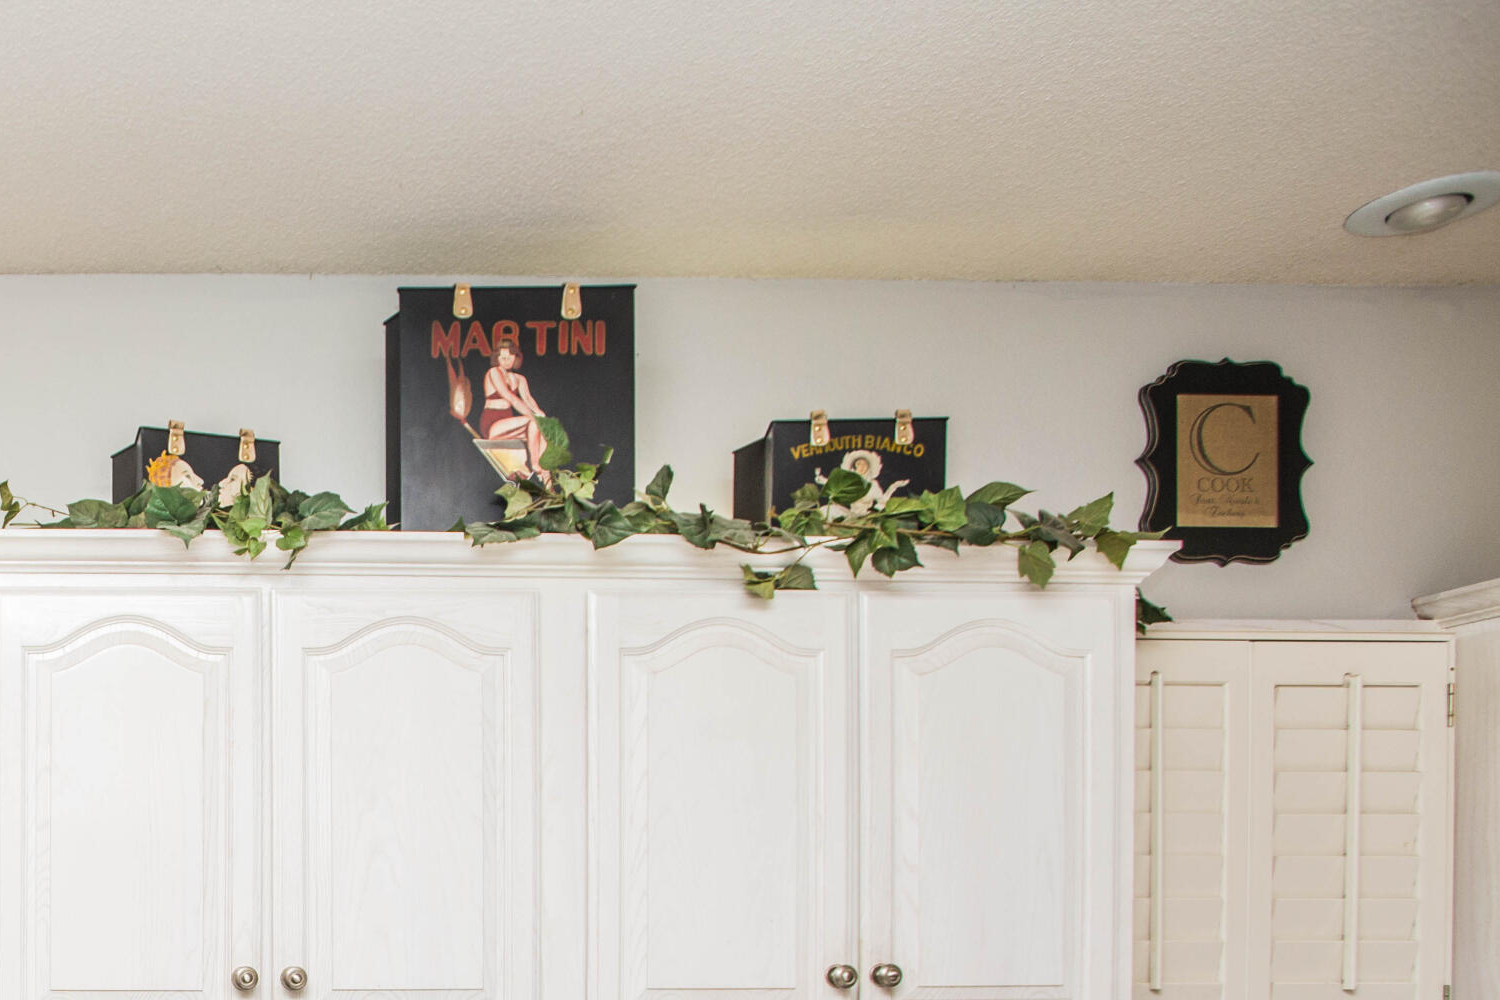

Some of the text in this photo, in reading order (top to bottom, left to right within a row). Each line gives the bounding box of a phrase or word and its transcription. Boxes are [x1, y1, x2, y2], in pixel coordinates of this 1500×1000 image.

[431, 320, 606, 358] MARTINI
[1189, 402, 1260, 475] C
[1197, 477, 1254, 493] COOK
